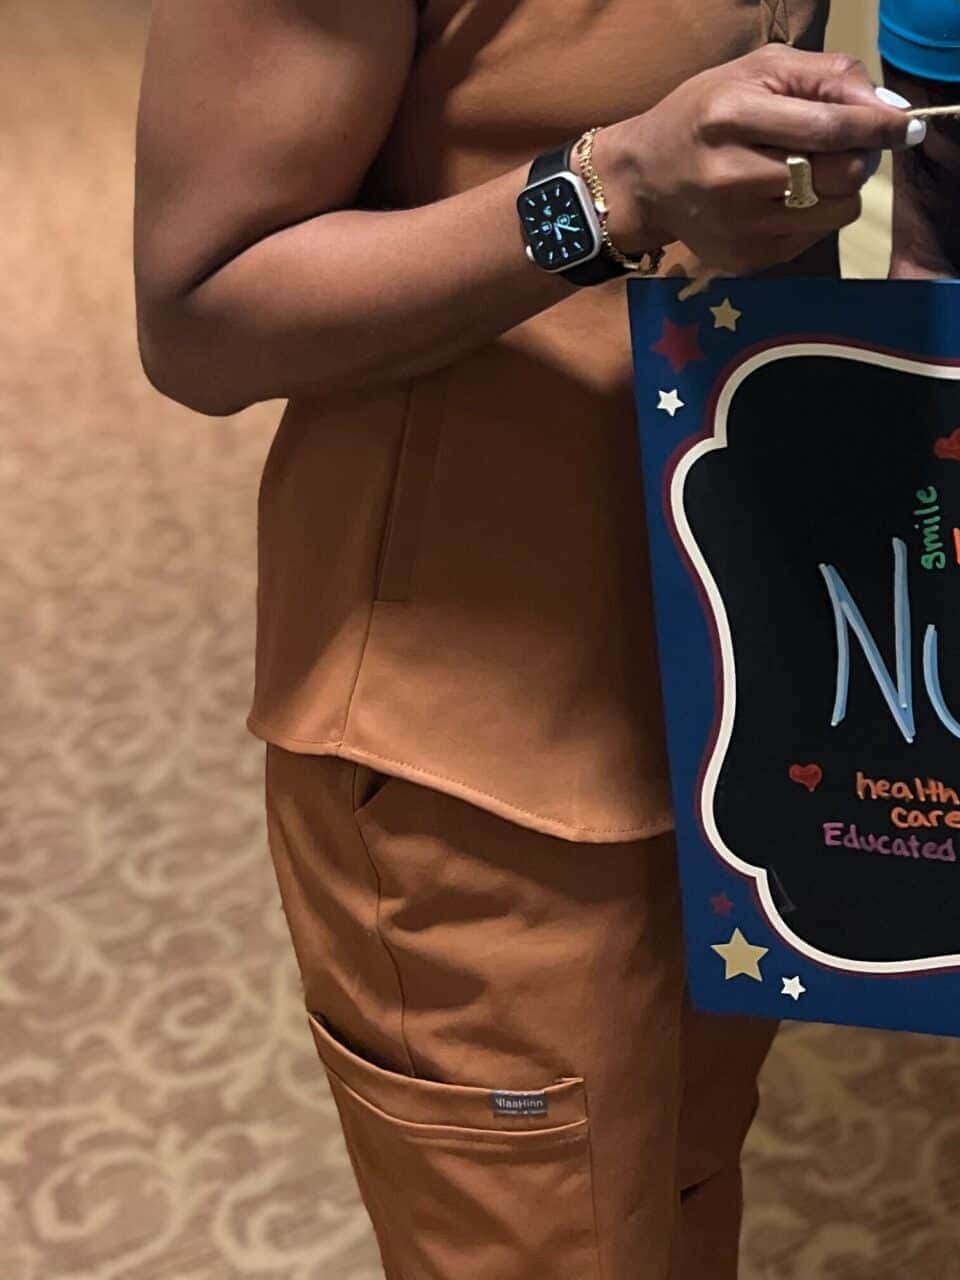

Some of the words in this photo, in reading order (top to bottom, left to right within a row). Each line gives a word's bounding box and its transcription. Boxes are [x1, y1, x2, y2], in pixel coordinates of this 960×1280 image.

[913, 486, 946, 570] smile
[856, 771, 960, 806] health
[822, 822, 957, 862] Educated
